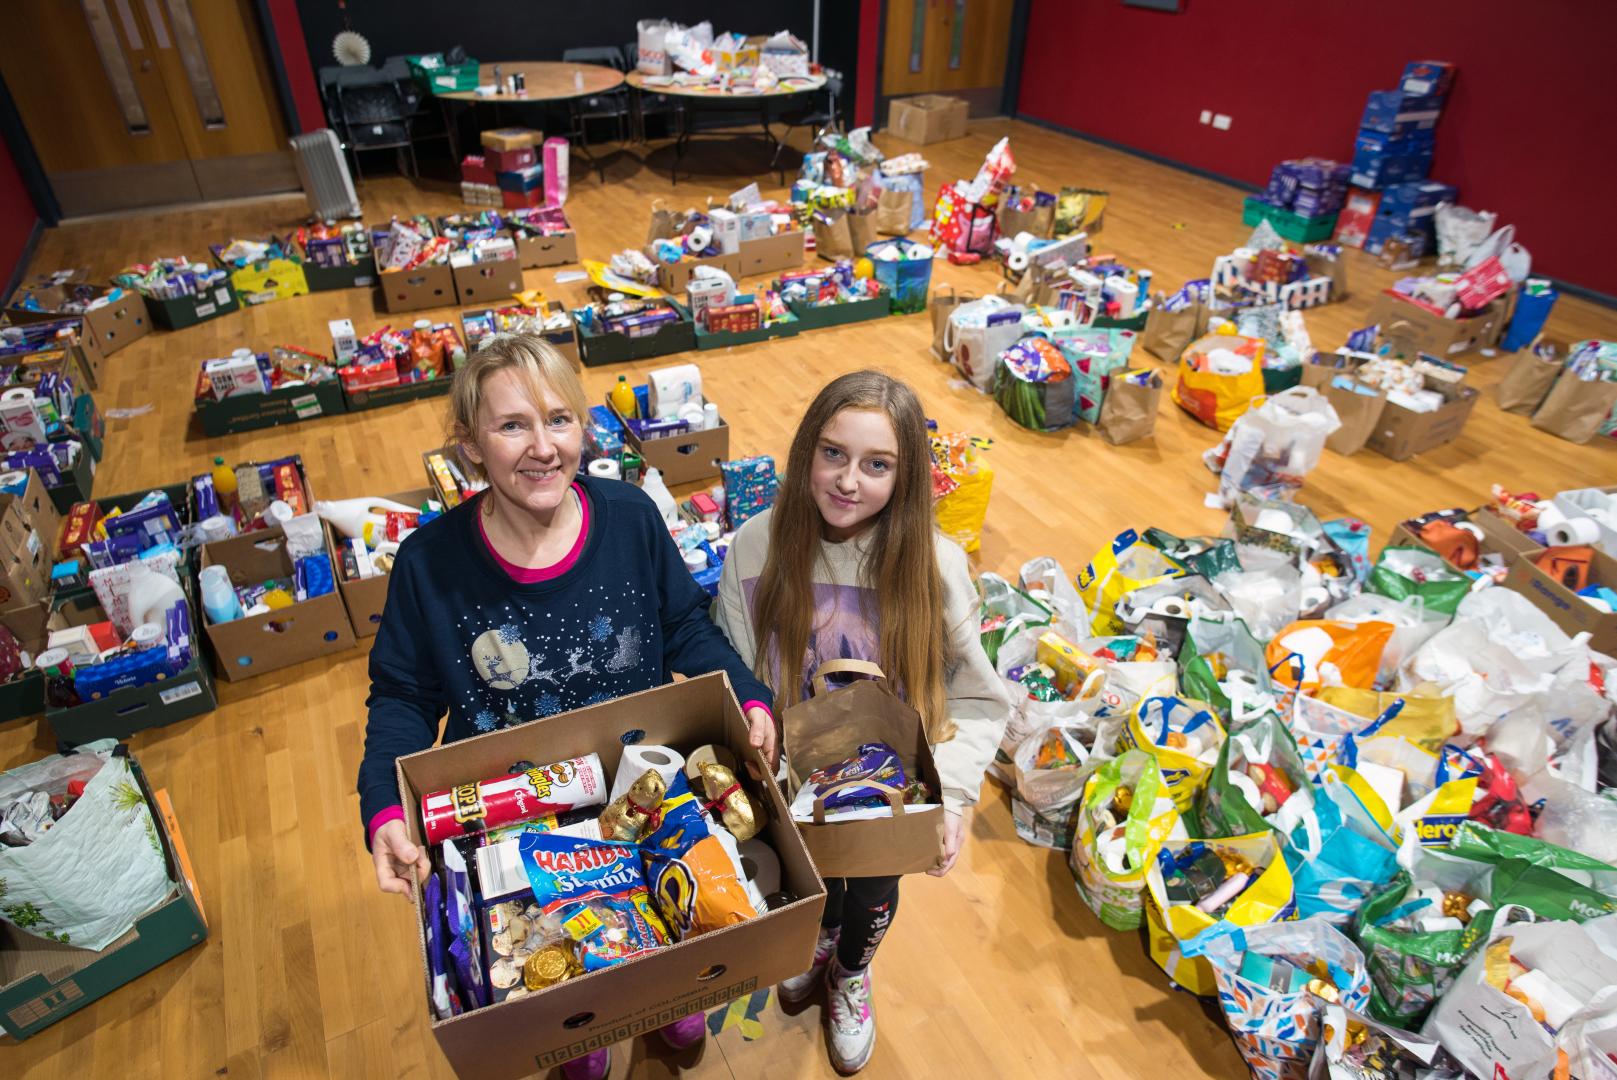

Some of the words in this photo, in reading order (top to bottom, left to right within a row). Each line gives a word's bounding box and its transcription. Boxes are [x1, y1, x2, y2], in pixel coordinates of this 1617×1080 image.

[212, 373, 233, 386] CORN
[526, 768, 553, 799] ingles
[859, 945, 878, 965] ust
[588, 1014, 633, 1031] Product
[635, 1007, 646, 1015] of
[648, 986, 709, 1011] COLOMBIA
[674, 1008, 687, 1017] 10
[689, 1002, 700, 1011] 11
[703, 996, 714, 1006] 12
[717, 991, 728, 1000] 13
[731, 986, 742, 996] 14
[745, 981, 755, 991] 15
